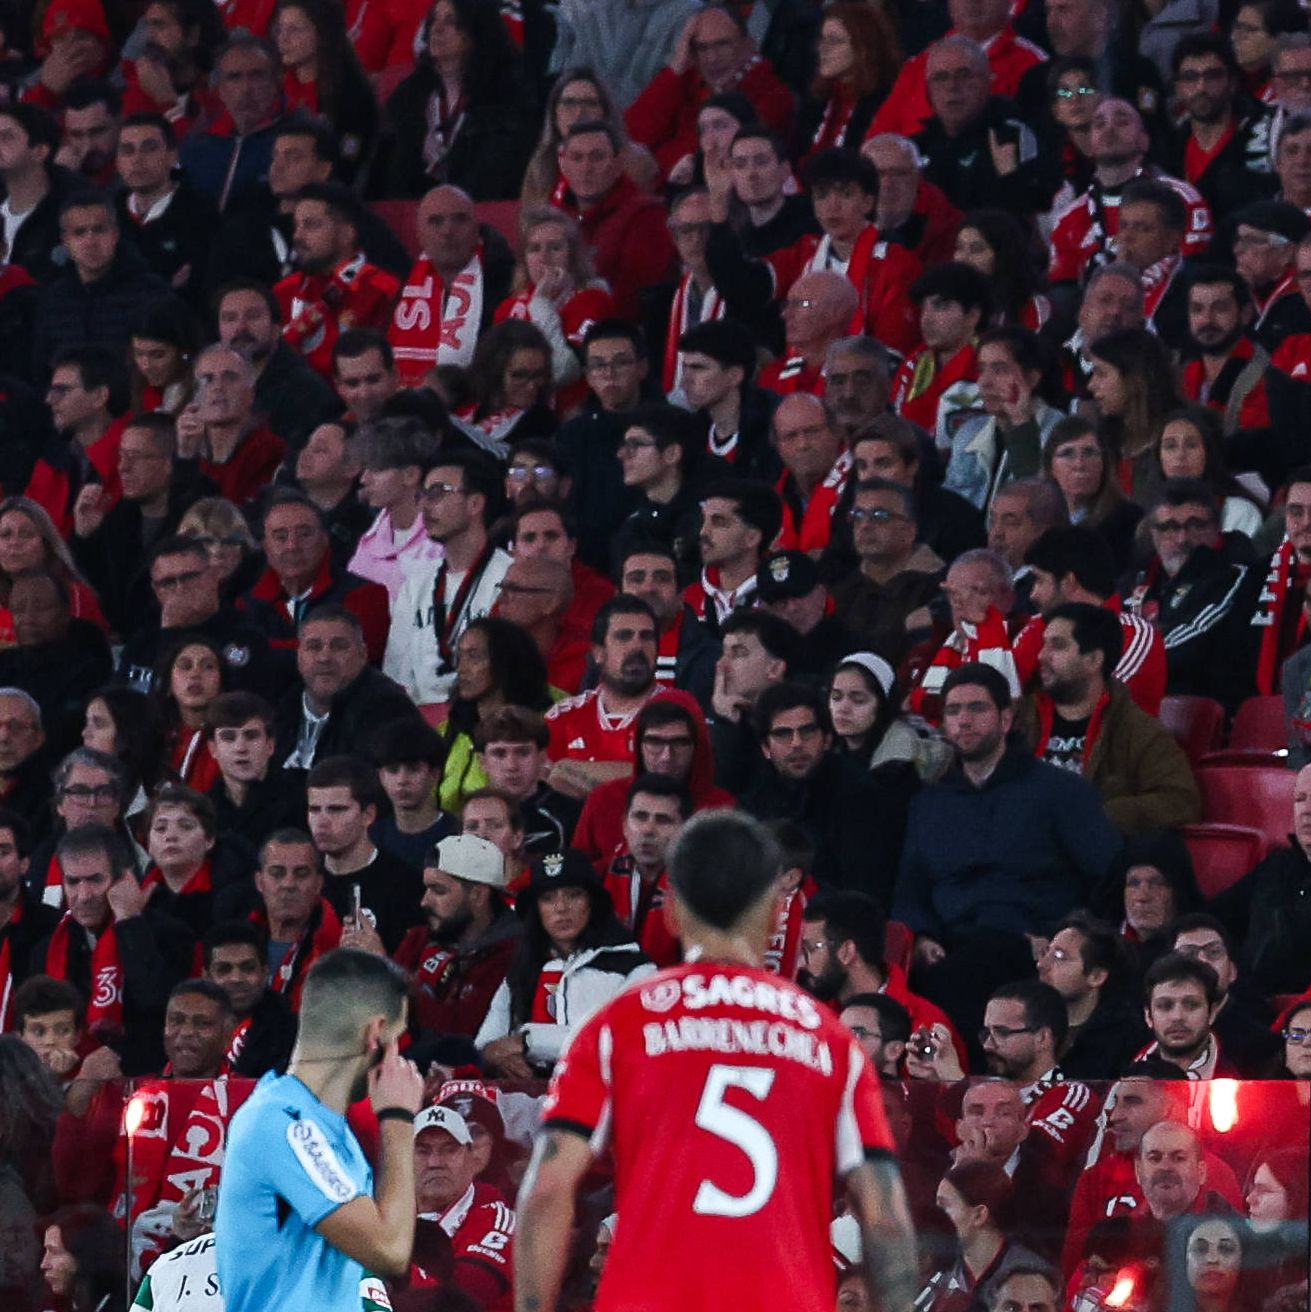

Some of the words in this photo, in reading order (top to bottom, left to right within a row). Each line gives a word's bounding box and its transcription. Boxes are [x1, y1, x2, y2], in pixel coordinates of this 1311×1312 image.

[682, 974, 822, 1030] SAGRES
[692, 1063, 779, 1218] 5
[176, 1274, 191, 1303] J.
[204, 1272, 223, 1297] S
